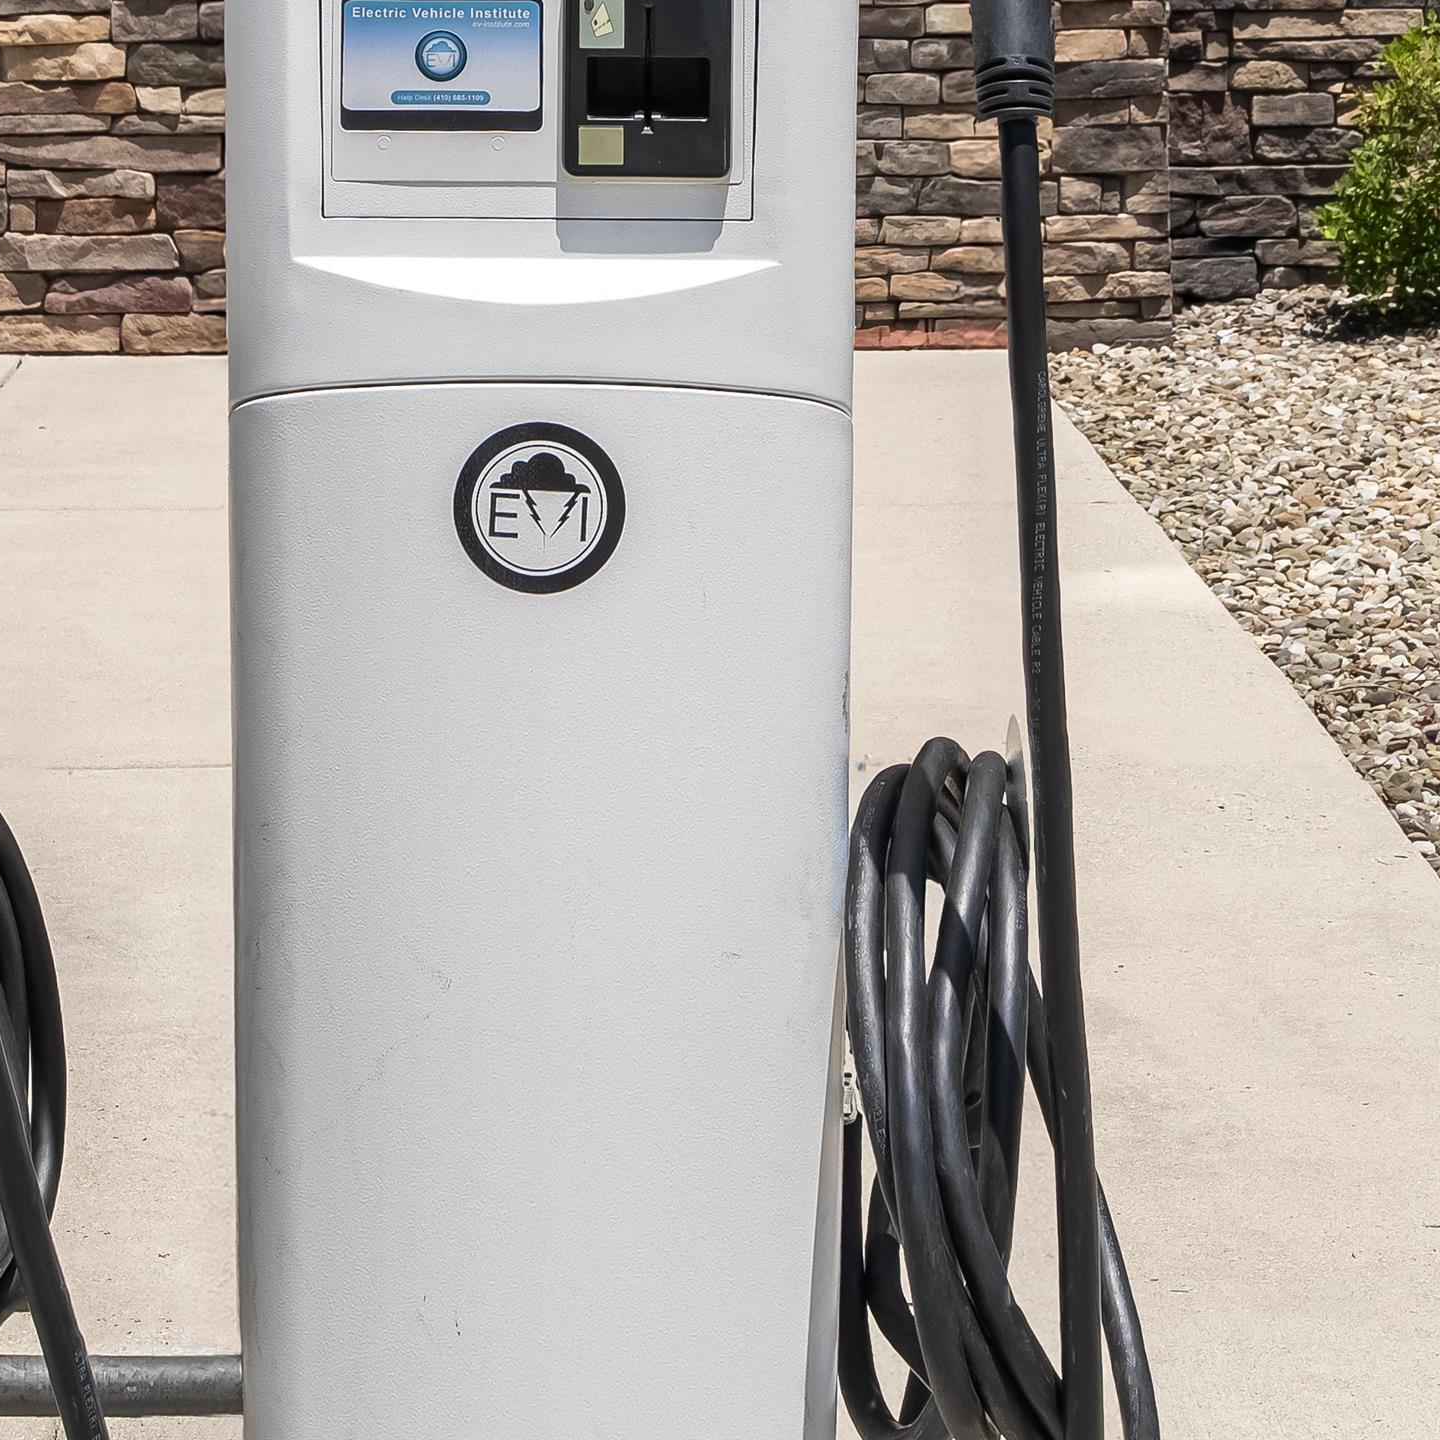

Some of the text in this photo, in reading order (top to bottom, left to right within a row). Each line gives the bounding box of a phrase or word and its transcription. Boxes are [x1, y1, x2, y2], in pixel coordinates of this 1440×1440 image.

[352, 6, 531, 19] Electric Vehicle Institute
[472, 20, 530, 28] ev-institute.com
[433, 94, 451, 102] (410)
[1034, 522, 1045, 571] ELECTRIC
[1031, 575, 1044, 620] VEHICLE
[1031, 625, 1042, 656] CABLE
